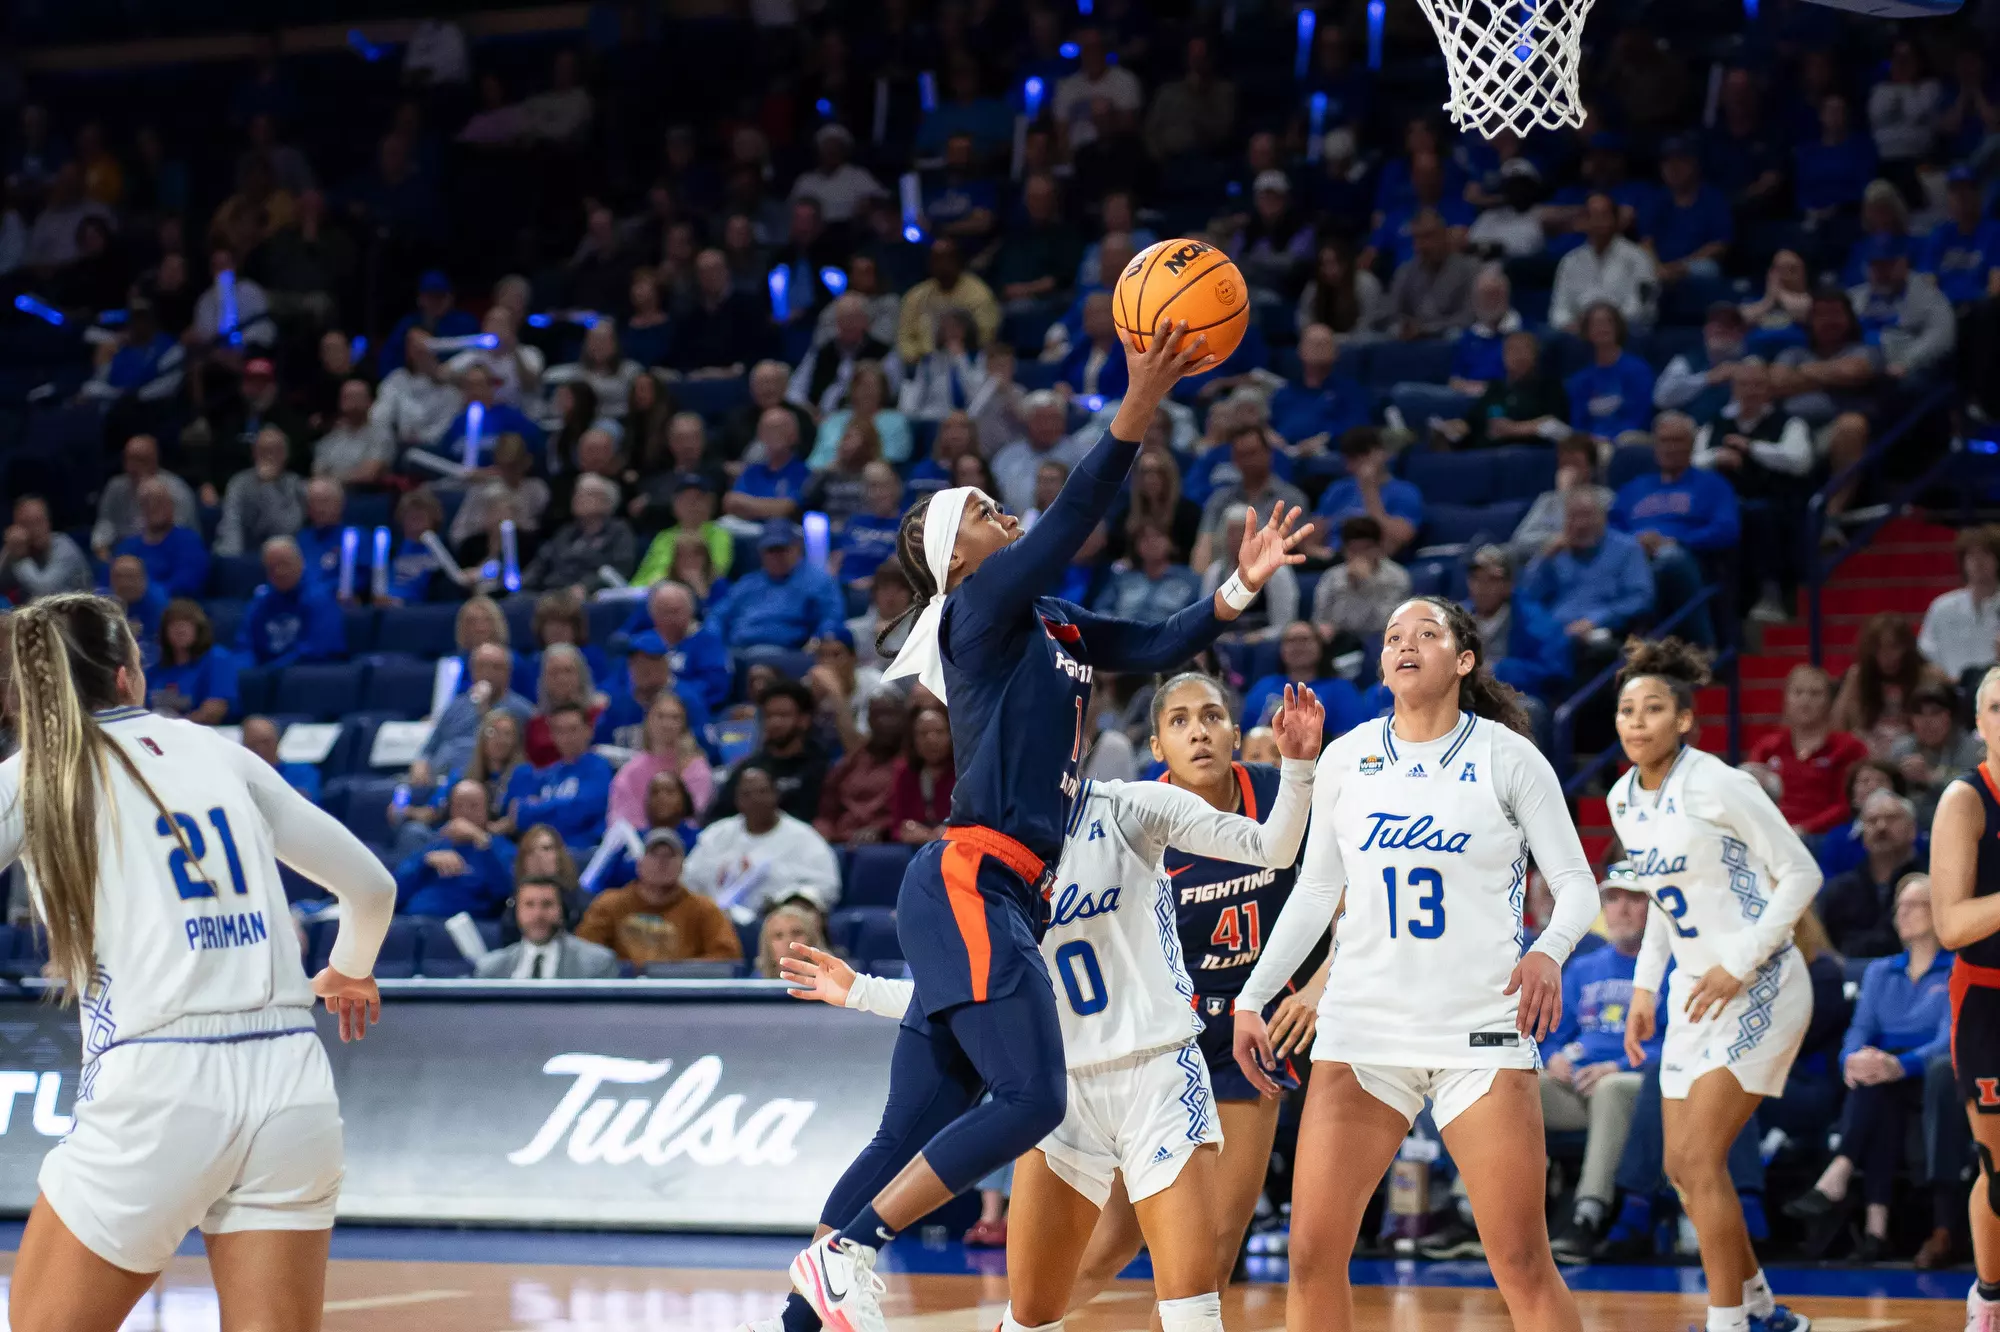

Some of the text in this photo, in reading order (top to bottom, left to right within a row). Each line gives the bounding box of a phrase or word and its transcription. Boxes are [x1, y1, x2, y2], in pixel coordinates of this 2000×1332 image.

[1071, 695, 1083, 763] 1
[155, 806, 248, 901] 21
[1359, 812, 1472, 854] Tulsa
[1047, 882, 1123, 930] lsa
[1180, 868, 1276, 906] FIGHTING
[1382, 866, 1446, 940] 13
[1211, 900, 1261, 951] 41
[1055, 938, 1110, 1017] 0
[507, 1052, 818, 1166] Tulsa
